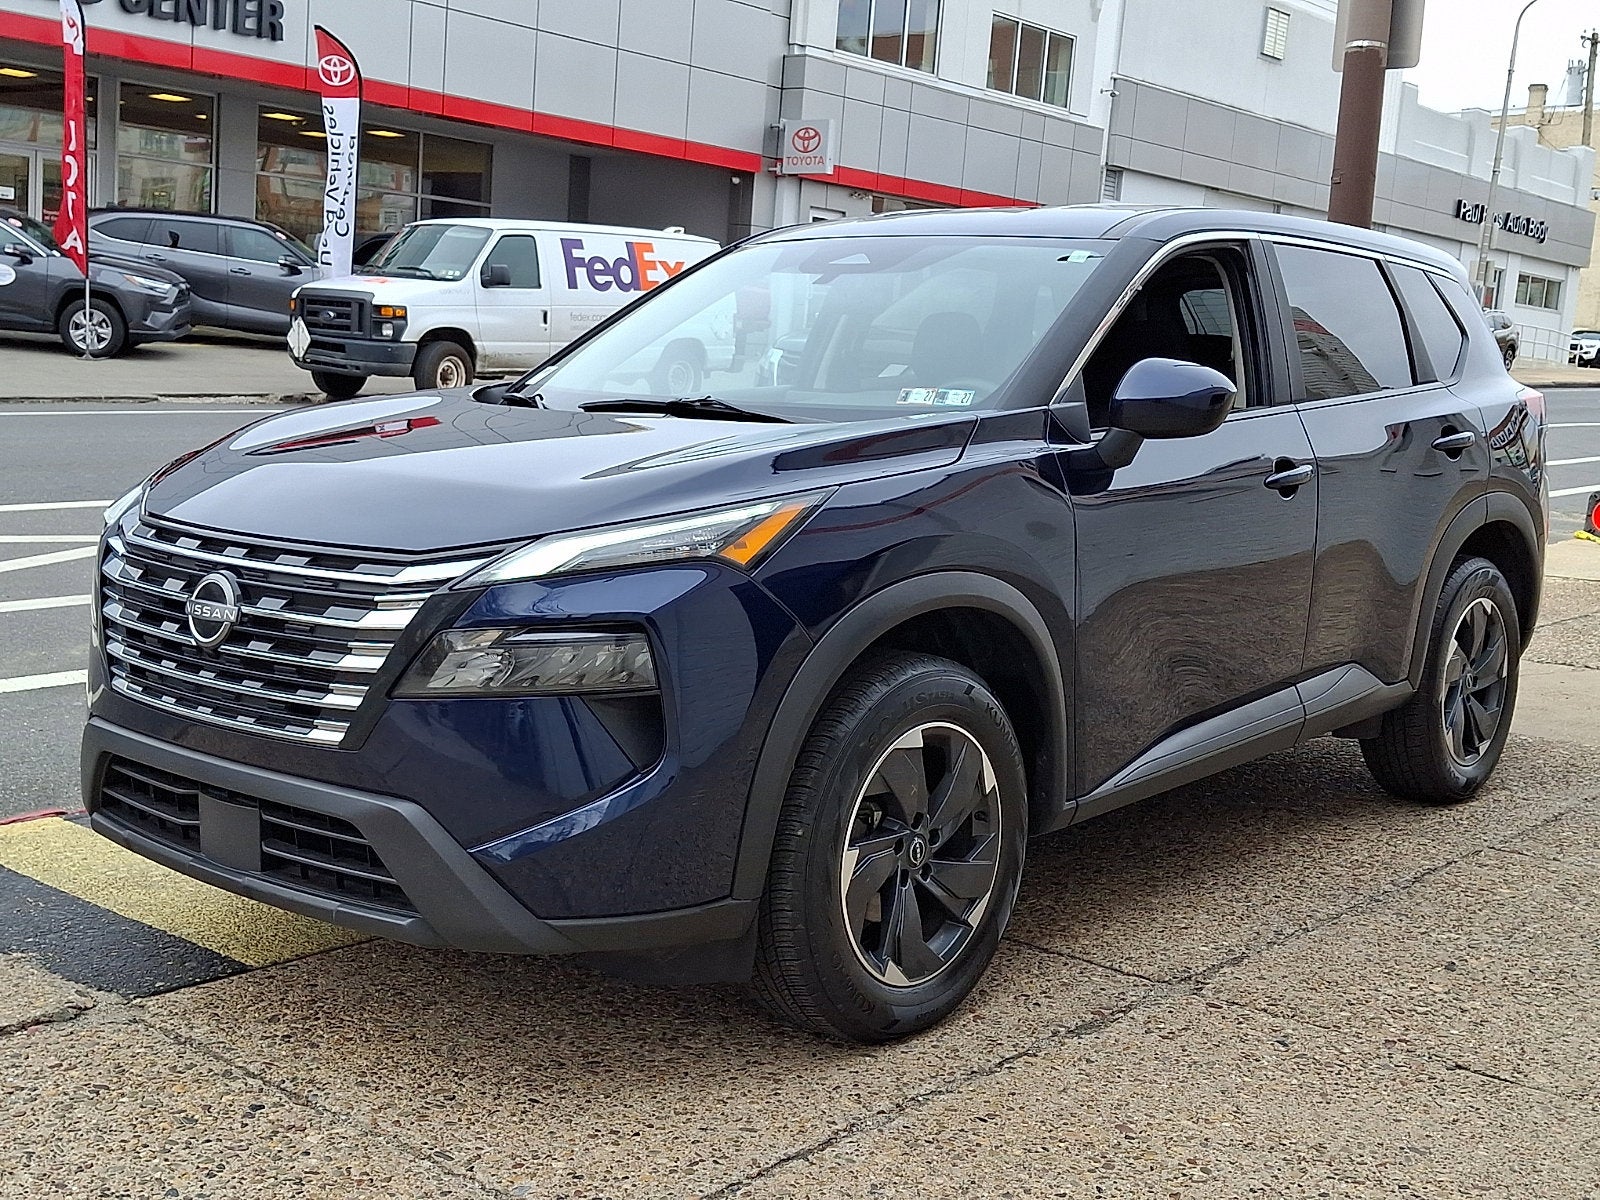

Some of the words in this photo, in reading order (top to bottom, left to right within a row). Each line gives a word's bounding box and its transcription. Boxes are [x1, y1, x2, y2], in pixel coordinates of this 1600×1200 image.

[786, 155, 825, 166] TOYOTA
[1456, 198, 1483, 225] Paul
[1506, 212, 1528, 235] Auto
[1526, 217, 1549, 245] Body
[186, 600, 236, 621] NISSAN
